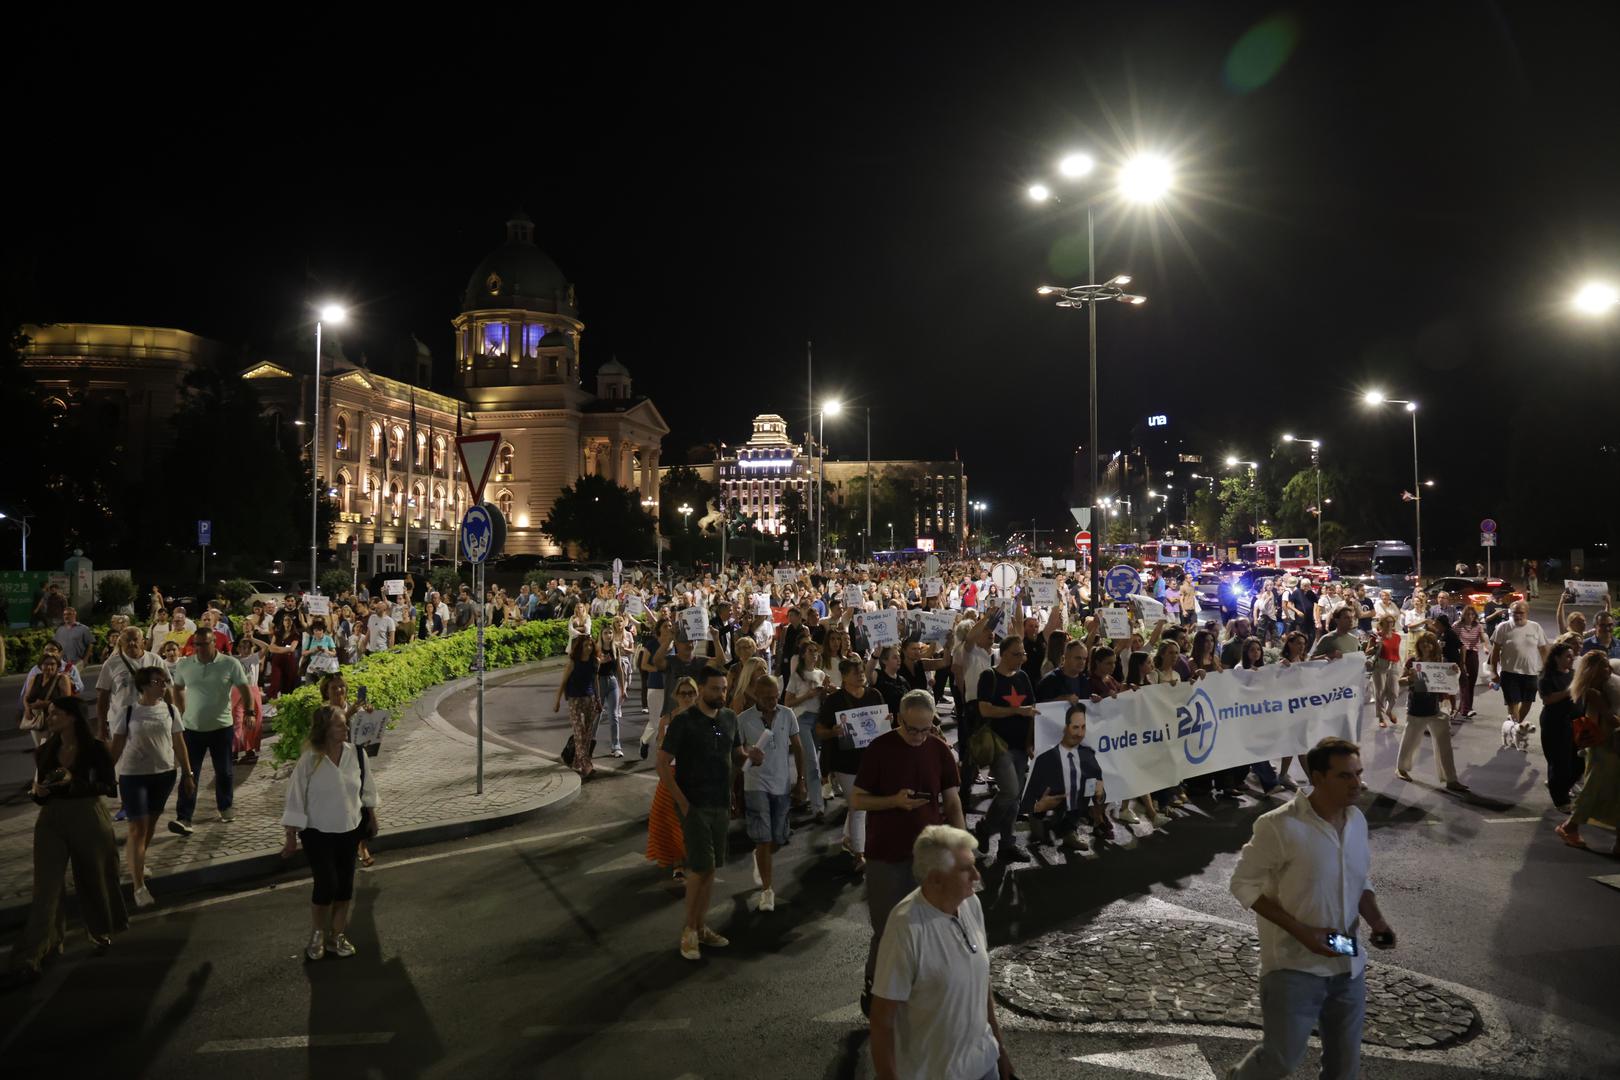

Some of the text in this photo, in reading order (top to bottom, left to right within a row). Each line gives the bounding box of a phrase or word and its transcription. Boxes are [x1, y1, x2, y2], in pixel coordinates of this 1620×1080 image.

[1148, 415, 1167, 426] una
[201, 522, 209, 533] P
[1098, 685, 1357, 753] Ovde su i 24 minuta previše.
